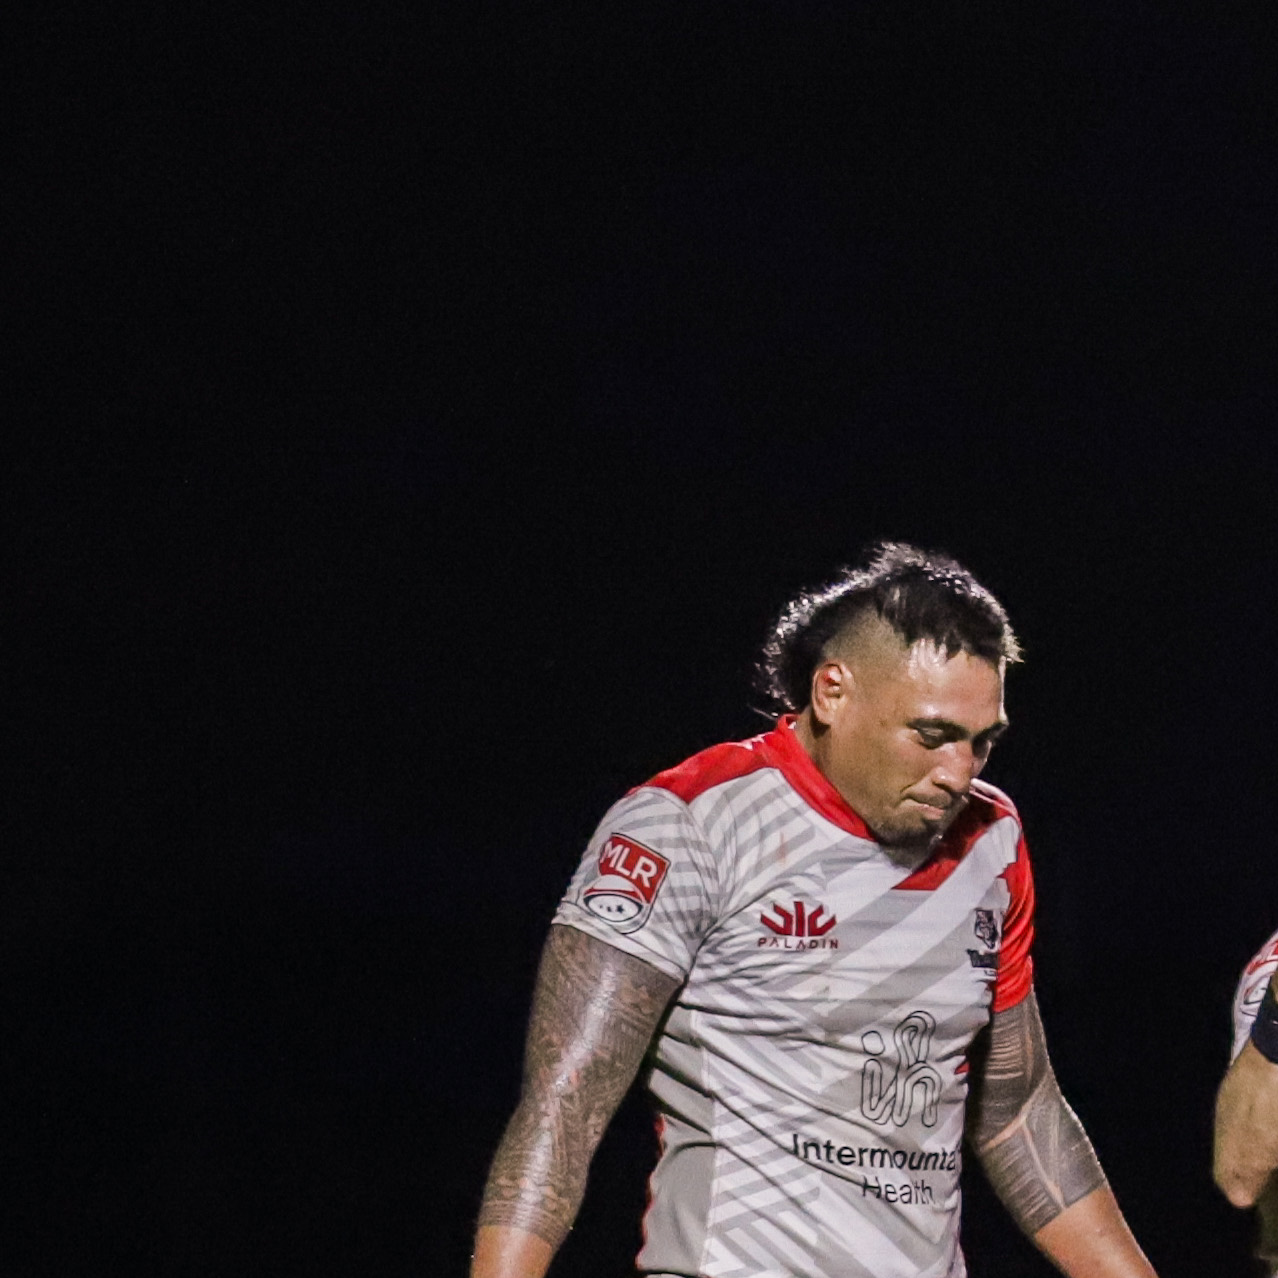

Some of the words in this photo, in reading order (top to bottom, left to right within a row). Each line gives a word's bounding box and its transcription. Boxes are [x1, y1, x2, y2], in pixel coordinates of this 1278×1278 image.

[601, 840, 657, 888] MLR
[757, 937, 838, 950] PALADIN
[792, 1133, 956, 1171] Intermounta
